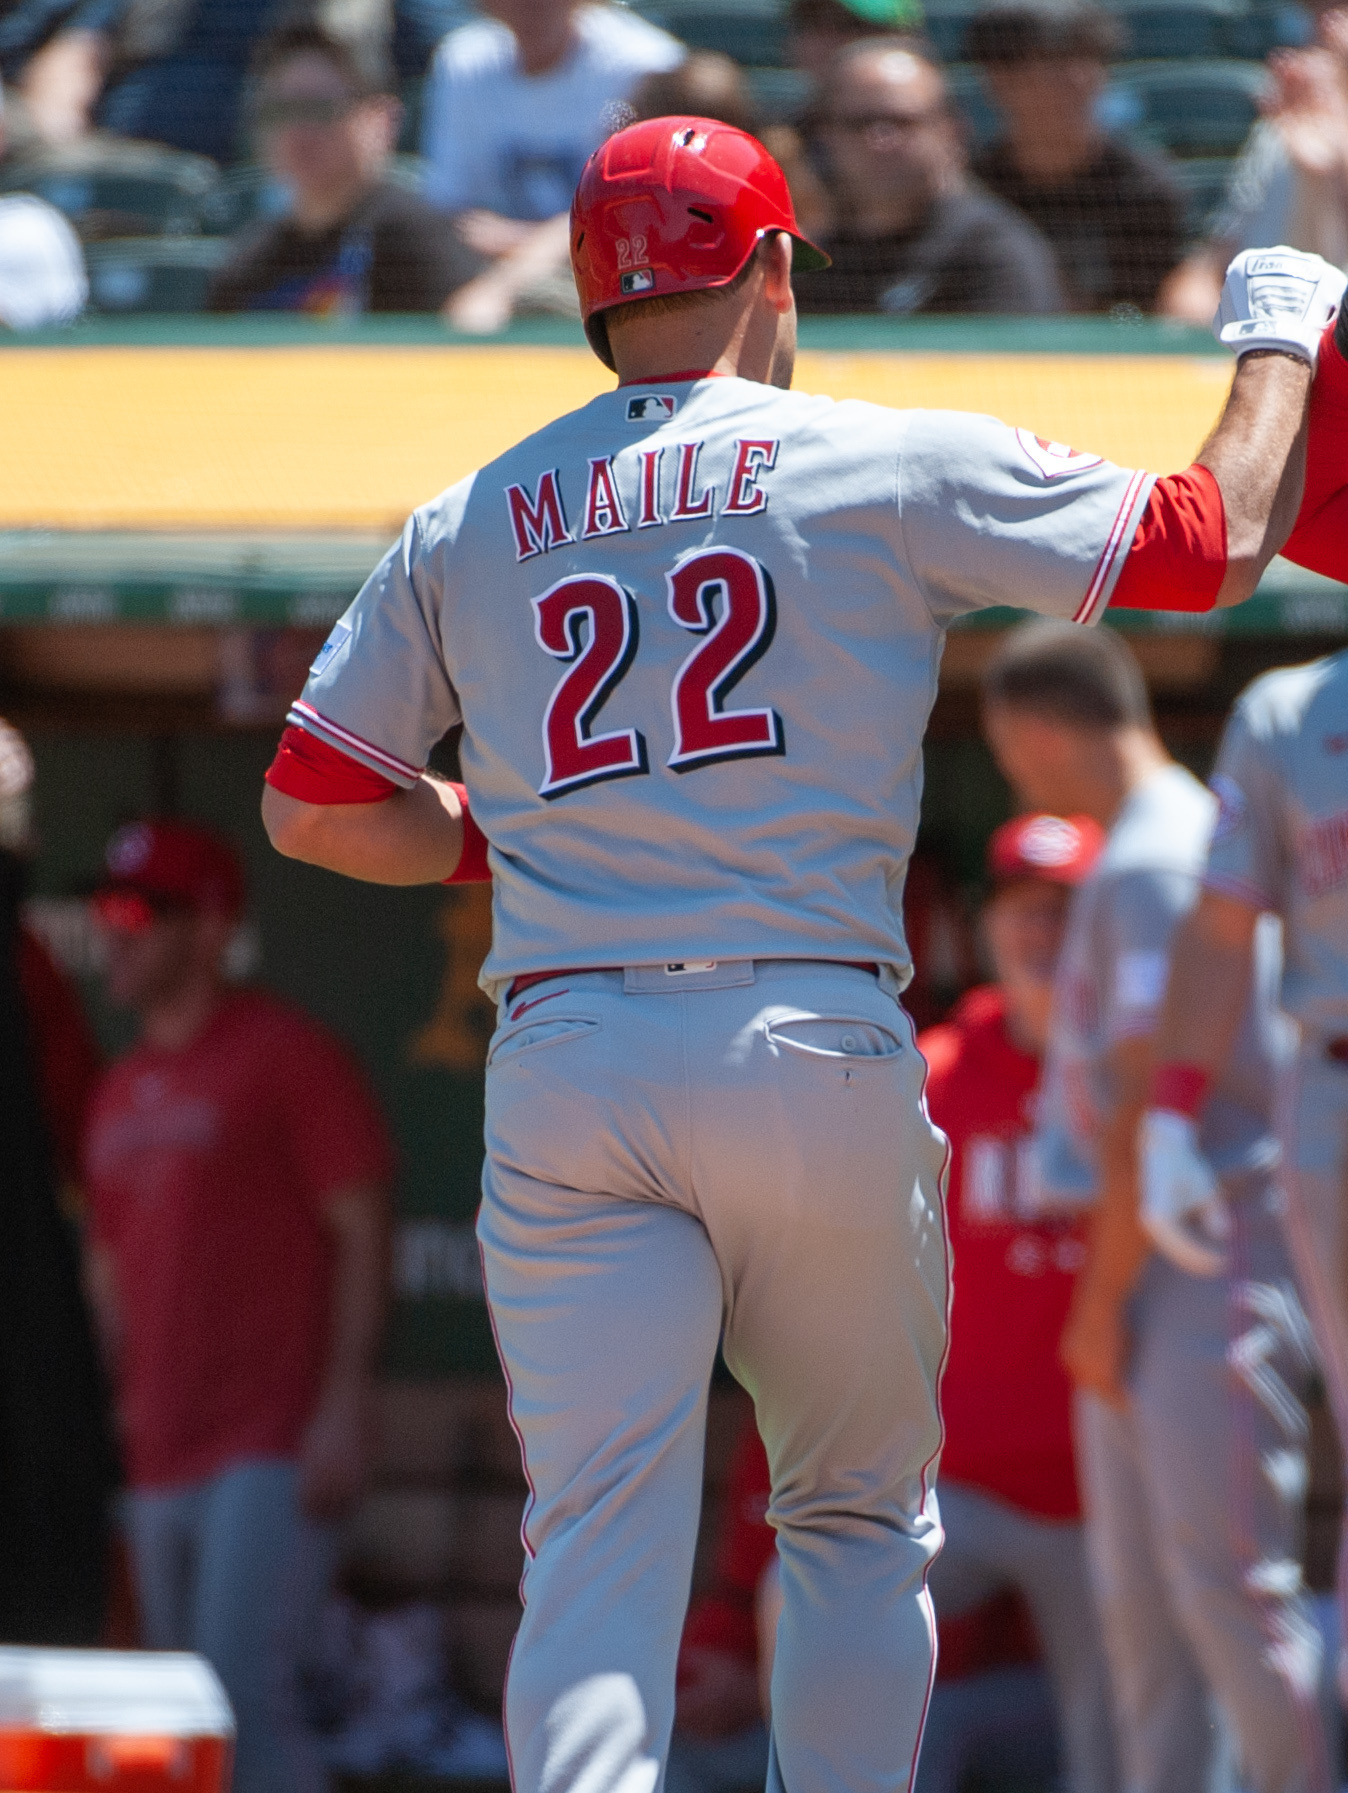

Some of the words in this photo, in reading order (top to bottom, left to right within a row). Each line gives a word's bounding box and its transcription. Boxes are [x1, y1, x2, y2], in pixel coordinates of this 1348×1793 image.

[614, 234, 650, 269] 22
[503, 438, 780, 562] MAILE
[530, 544, 787, 802] 22
